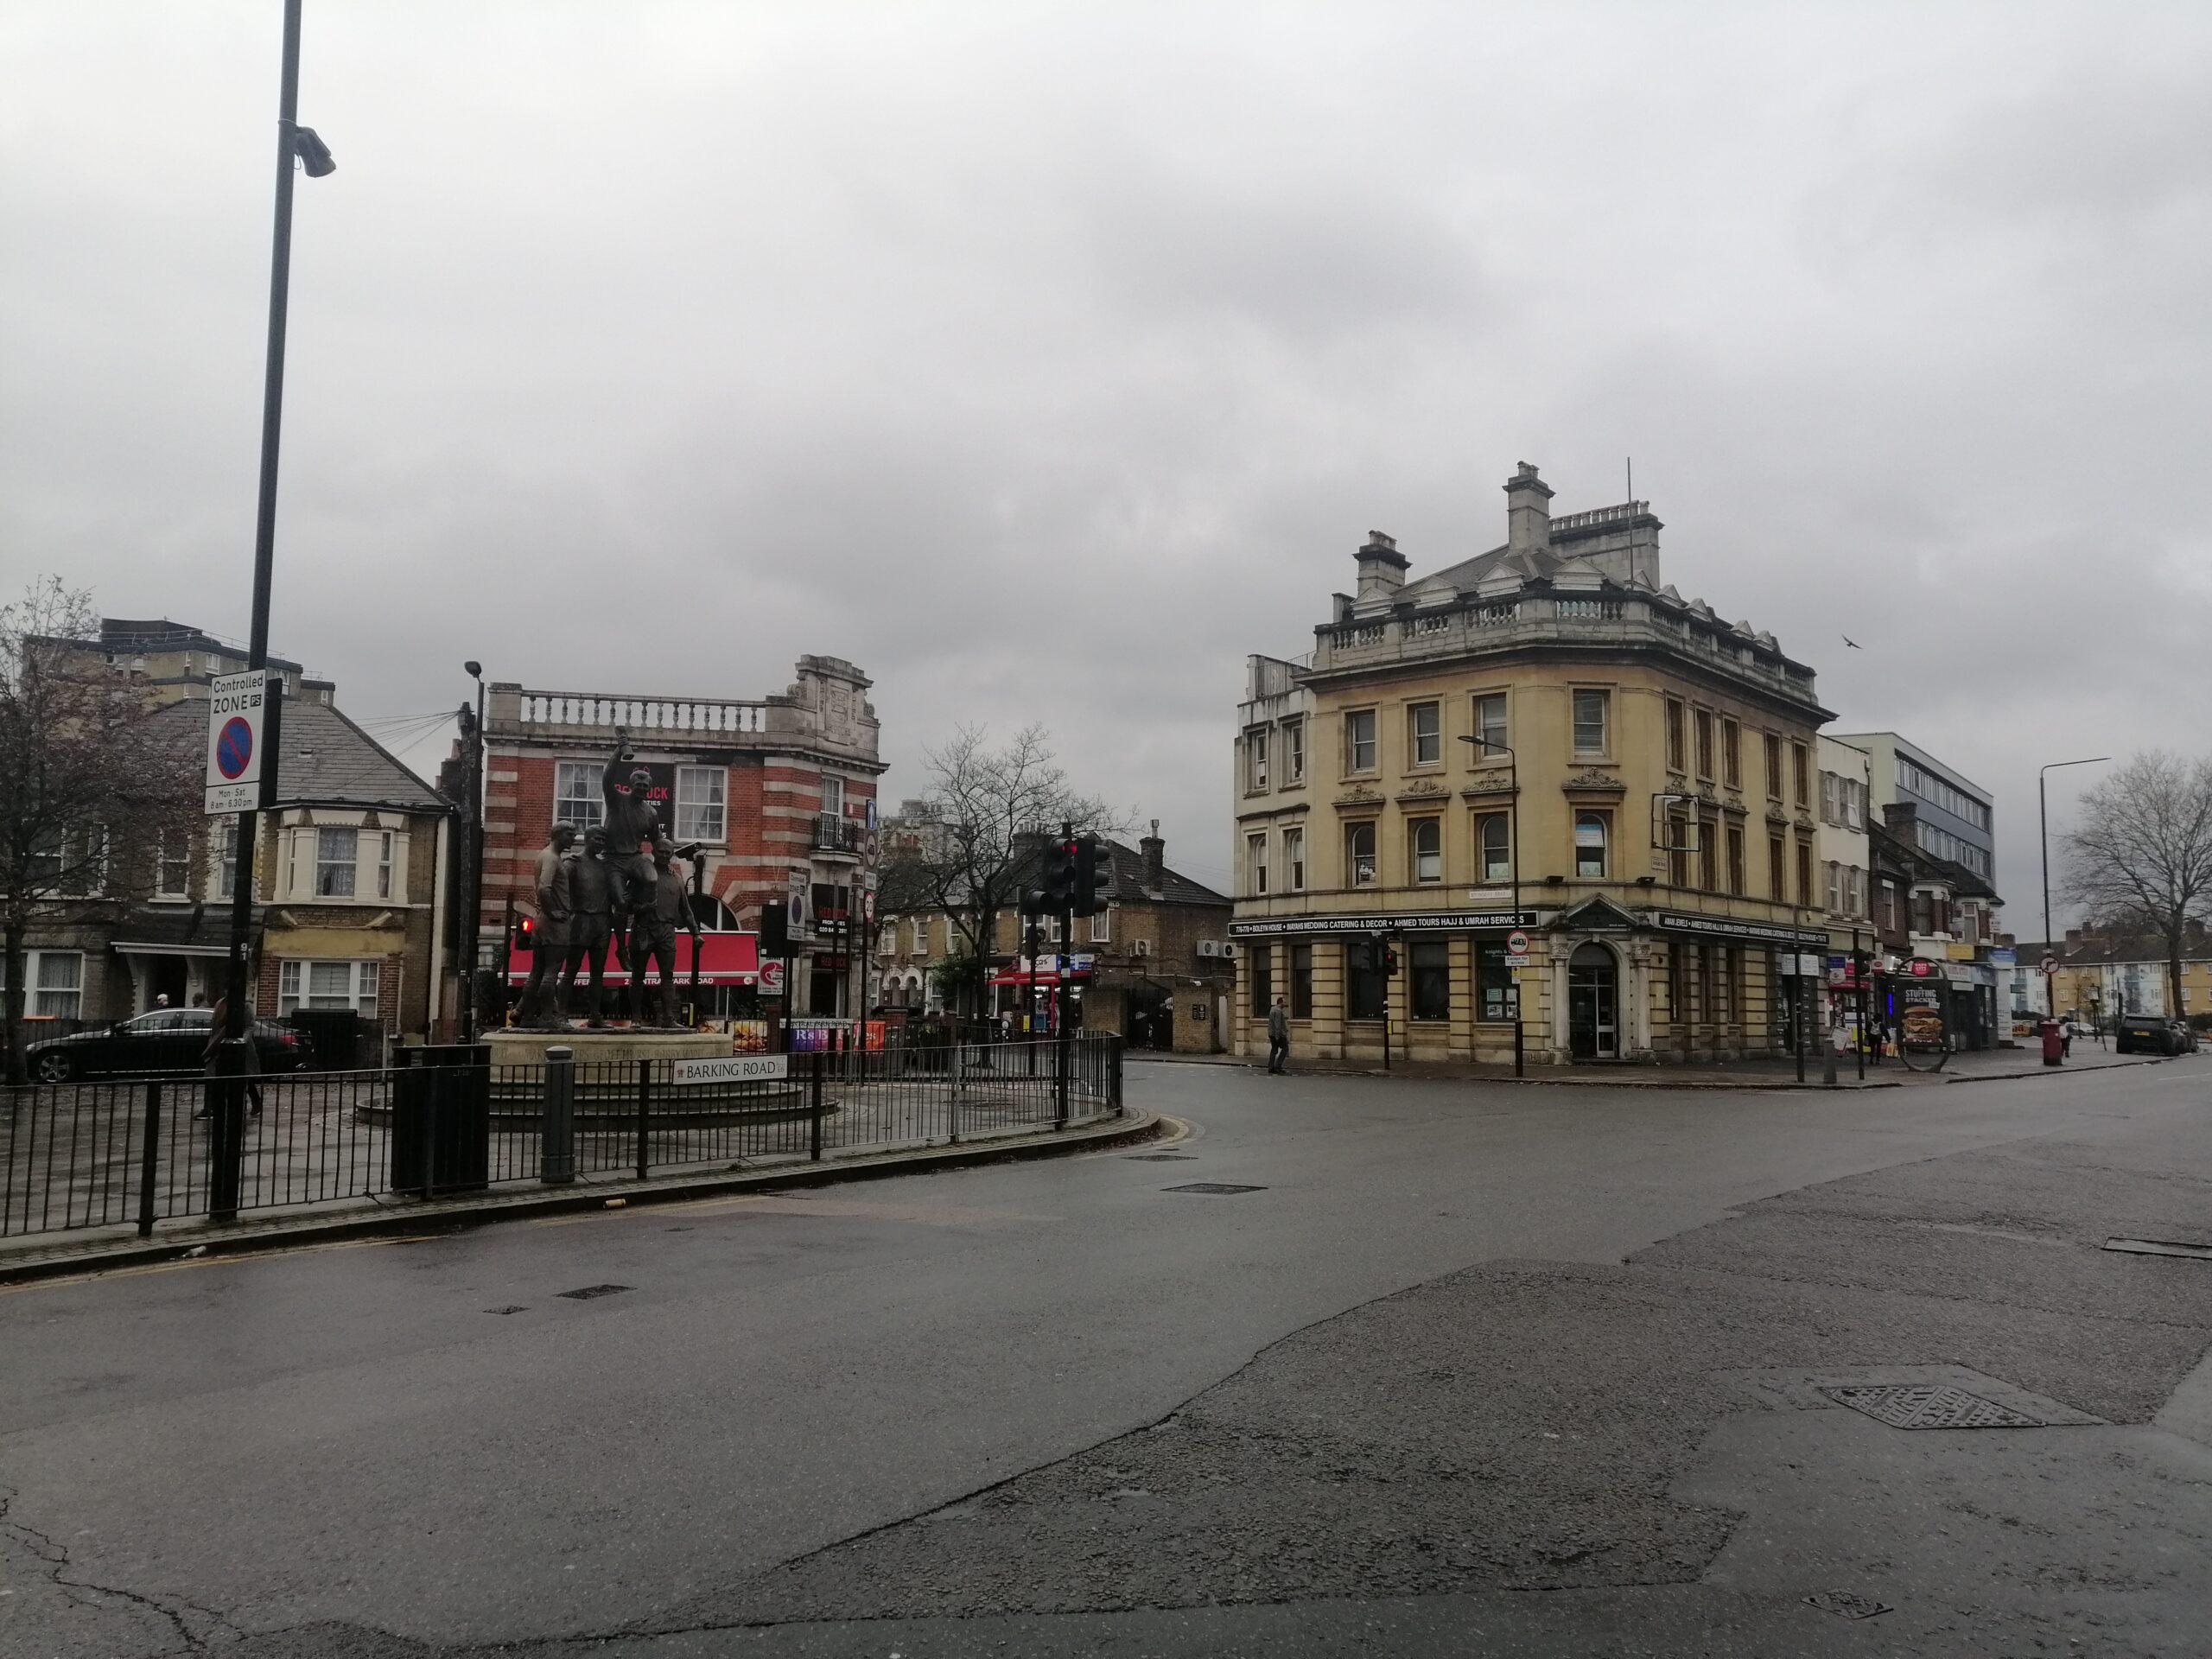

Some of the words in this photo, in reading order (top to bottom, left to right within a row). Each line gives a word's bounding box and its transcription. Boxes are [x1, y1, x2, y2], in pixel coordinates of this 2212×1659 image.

[213, 674, 263, 694] Controlled
[213, 695, 248, 714] ZONE
[219, 790, 231, 798] Mon
[235, 788, 245, 797] Sat
[866, 900, 873, 912] 20
[1268, 923, 1283, 931] HOUSE
[1304, 920, 1329, 930] WEDDING
[1329, 919, 1359, 929] CATERING
[1359, 919, 1365, 928] &
[1365, 918, 1388, 928] DECOR
[1394, 918, 1417, 927] AHMED
[1418, 918, 1440, 926] TOURS
[1459, 917, 1464, 925] &
[1491, 916, 1524, 925] SERVICS
[1905, 989, 1937, 998] STUFFING
[687, 1063, 739, 1078] BARKING
[743, 1061, 776, 1076] ROAD
